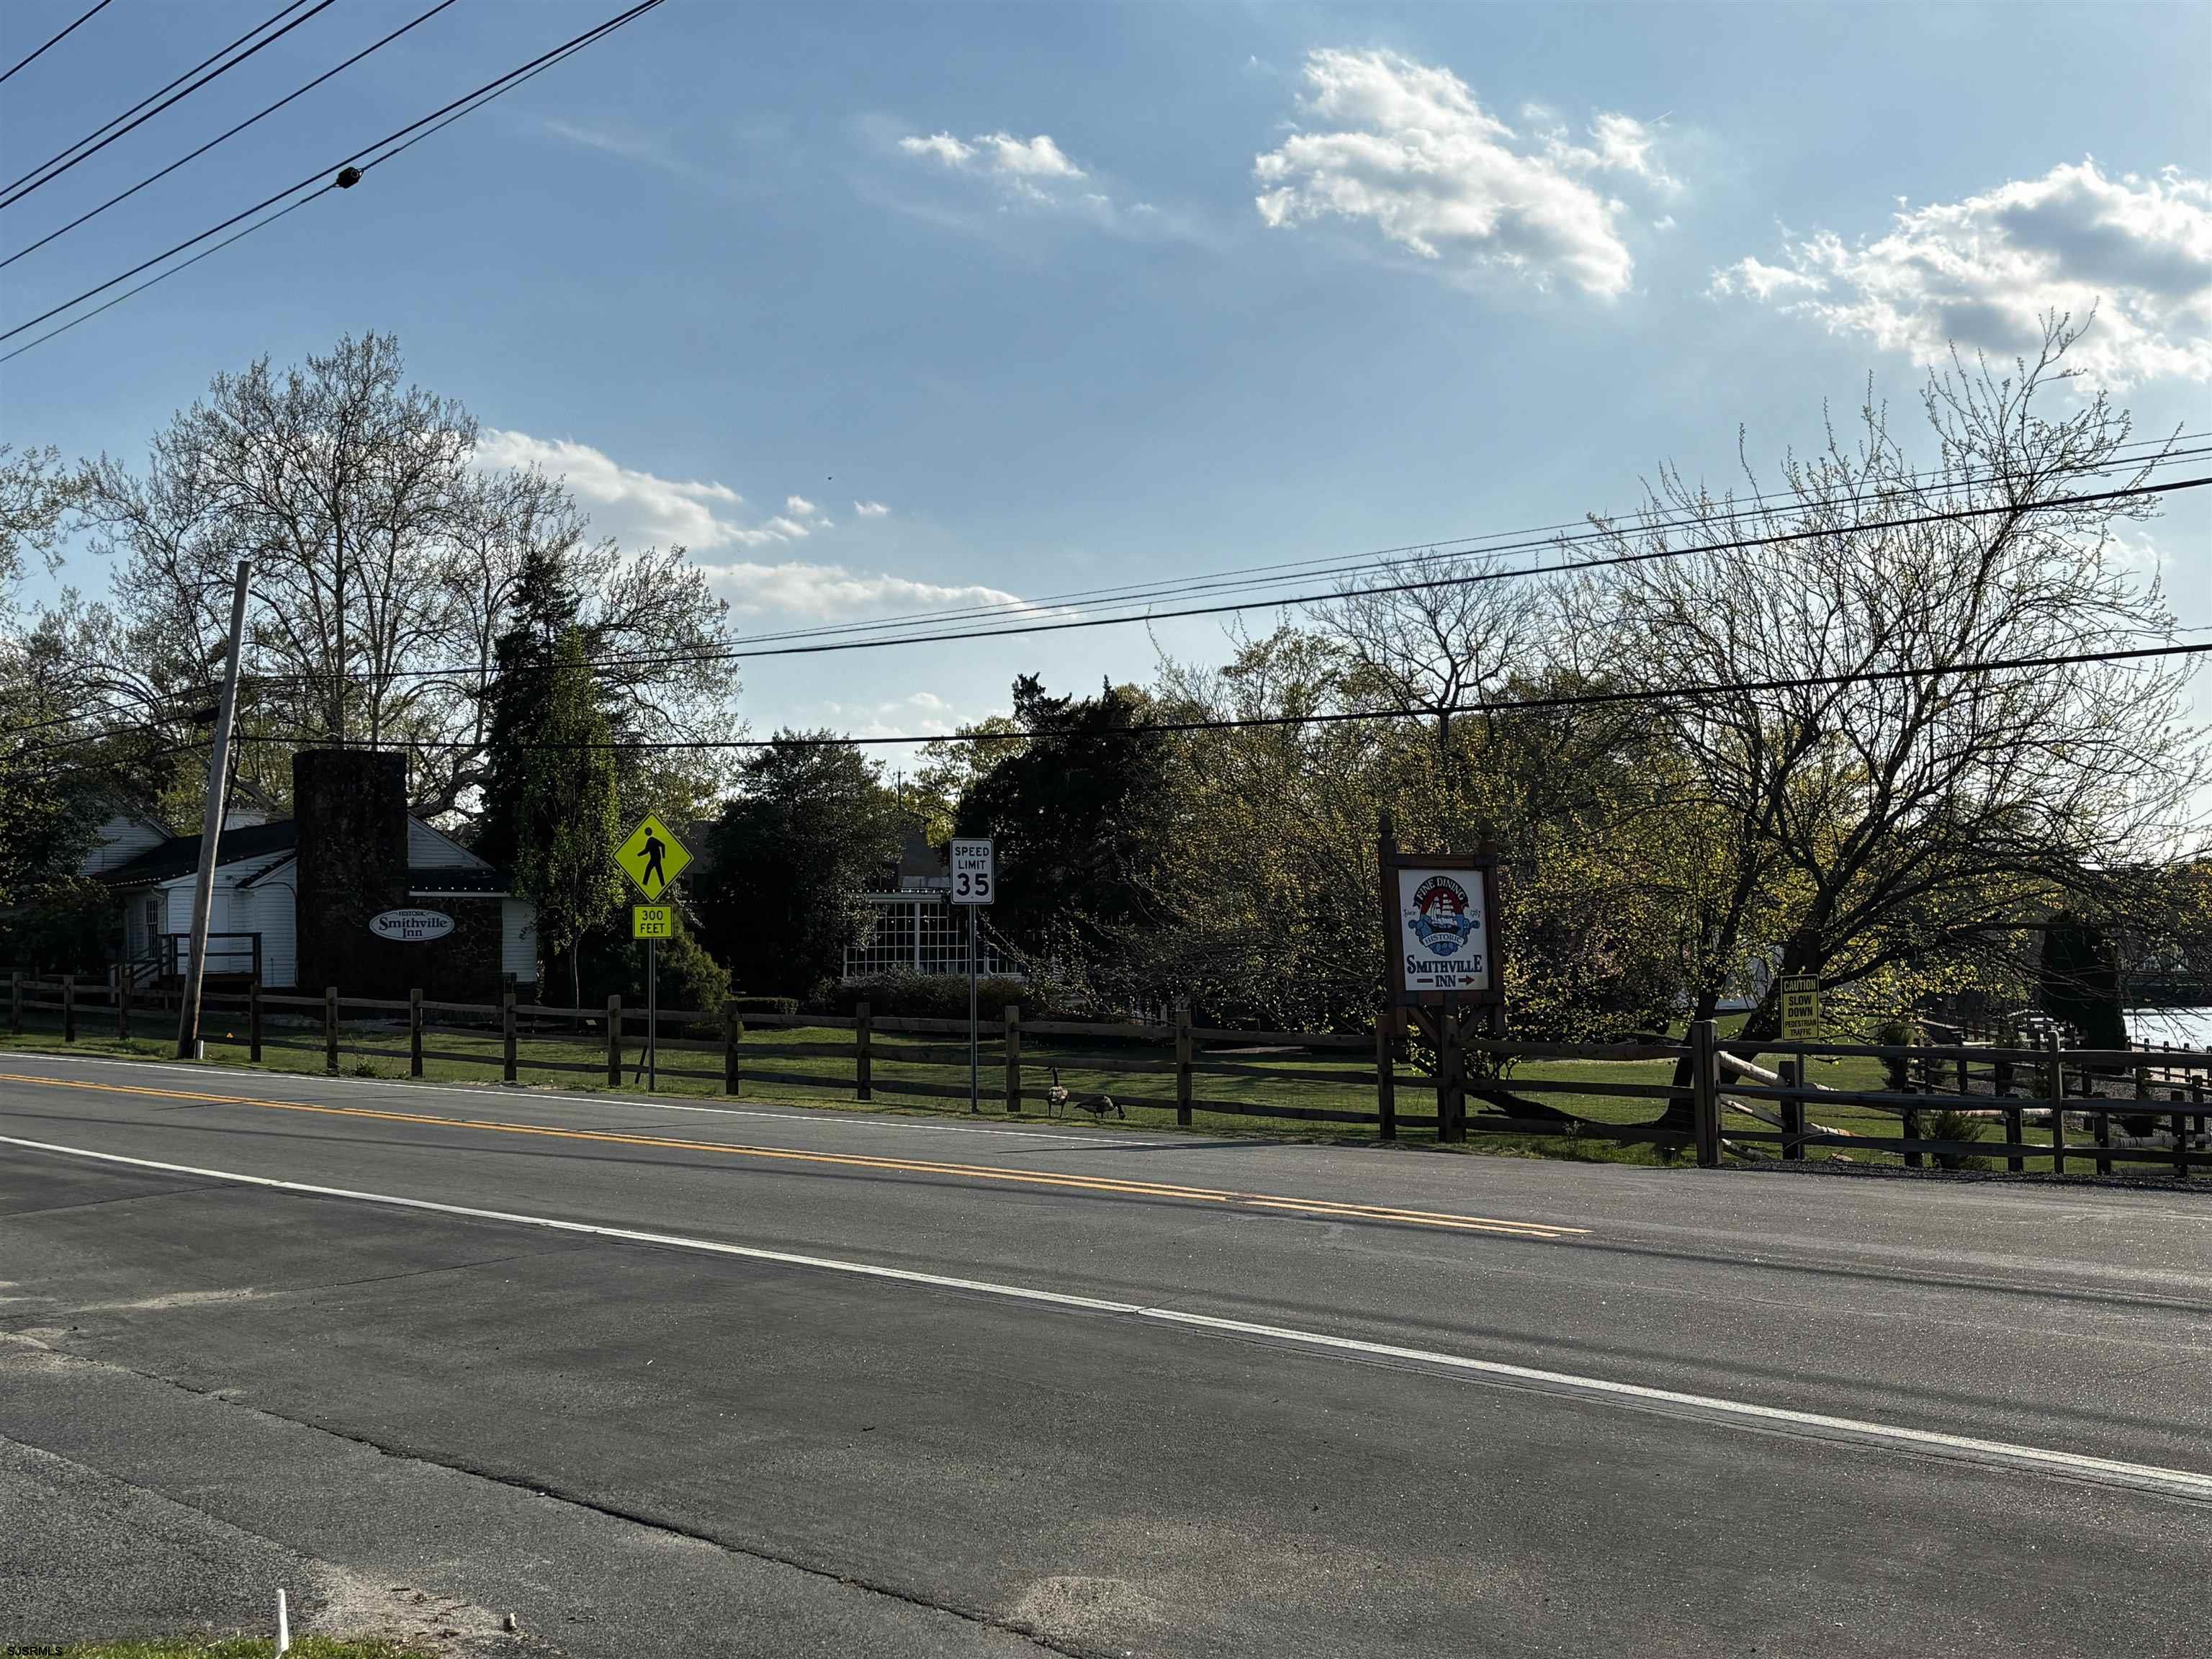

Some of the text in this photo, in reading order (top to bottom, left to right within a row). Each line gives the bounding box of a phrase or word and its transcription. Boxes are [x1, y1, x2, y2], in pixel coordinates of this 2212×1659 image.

[955, 846, 989, 856] SPEED
[958, 860, 986, 870] LIMIT
[956, 873, 989, 896] 35
[1416, 876, 1466, 900] FINE DINING
[642, 910, 663, 920] 300
[379, 917, 448, 931] Smithville
[640, 923, 665, 933] FEET
[403, 928, 423, 938] Inn
[1425, 934, 1462, 945] HISTORIC
[1406, 954, 1483, 974] SMITHVILLE
[1435, 975, 1456, 987] INN
[1784, 979, 1816, 992] CAUTION
[1789, 994, 1812, 1006] SLOW
[1788, 1007, 1813, 1017] DOWN
[1785, 1019, 1817, 1028] PEDESTRIAN
